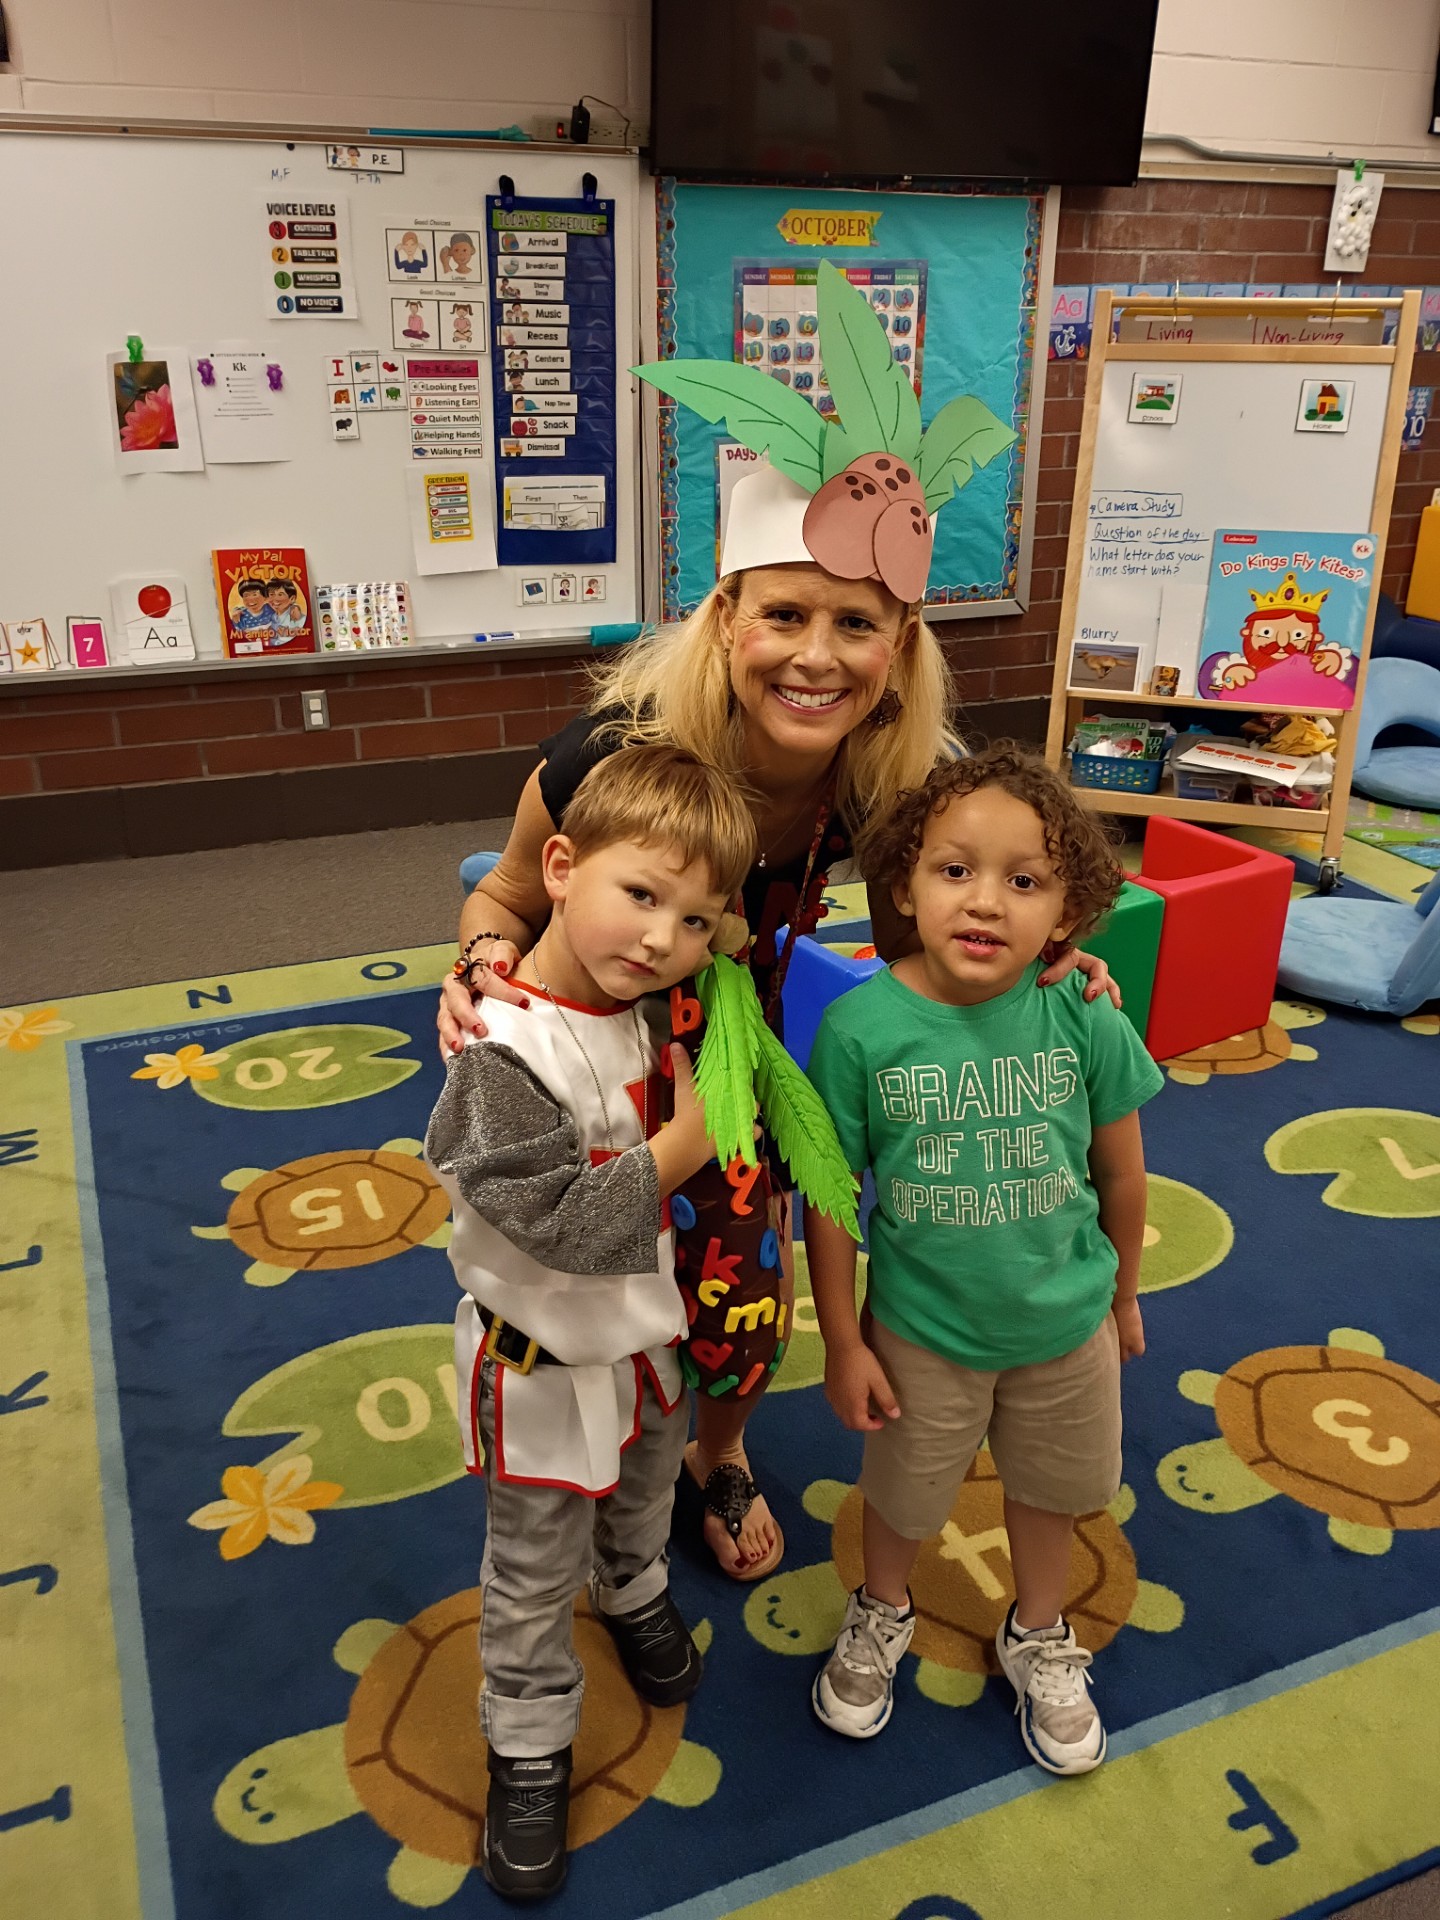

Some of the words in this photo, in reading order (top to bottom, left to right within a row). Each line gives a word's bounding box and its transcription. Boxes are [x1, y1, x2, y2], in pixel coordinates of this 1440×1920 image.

[372, 154, 391, 165] P.E.
[266, 203, 298, 216] VOICE
[300, 203, 336, 217] LEVELS
[294, 224, 331, 233] OUTSIDE
[498, 212, 541, 228] TODAY'S
[546, 215, 599, 231] SCHEDULE
[791, 217, 866, 237] OCTOBER
[527, 237, 559, 247] Arrival
[276, 248, 285, 262] 2
[313, 249, 335, 258] TALK
[525, 262, 559, 271] Breakfast
[297, 273, 337, 283] WHISPER
[300, 298, 313, 307] NO
[1054, 294, 1084, 318] Aa
[535, 309, 562, 319] Music
[776, 321, 784, 334] 5
[803, 319, 812, 332] 6
[895, 320, 910, 332] 10
[1146, 321, 1193, 344] Living
[1262, 326, 1344, 345] Non-Living
[527, 331, 559, 341] Recess
[535, 354, 564, 364] Centers
[747, 346, 761, 358] 11
[773, 347, 788, 361] 12
[796, 346, 812, 358] 13
[232, 362, 247, 371] Kk
[425, 384, 457, 392] Looking
[458, 384, 477, 392] Eyes
[535, 377, 559, 387] Lunch
[796, 373, 813, 388] 20
[425, 399, 460, 407] Listening
[428, 415, 451, 423] Quiet
[453, 415, 480, 423] Mouth
[543, 420, 569, 430] Snack
[1312, 422, 1333, 430] Home
[1410, 416, 1426, 438] 10
[424, 431, 454, 441] Helping
[456, 431, 480, 439] Hands
[430, 448, 462, 458] Walking
[527, 443, 560, 451] Dismissal
[725, 449, 758, 461] DAYS
[1097, 497, 1139, 514] Camera
[1141, 497, 1176, 517] Study
[1094, 523, 1142, 540] Question
[1147, 527, 1161, 539] of
[1161, 528, 1180, 538] the
[1355, 544, 1369, 553] Kk
[240, 552, 259, 563] My
[1090, 547, 1119, 561] What
[1123, 547, 1154, 561] letter
[1155, 549, 1175, 561] does
[1177, 553, 1205, 567] your
[224, 564, 303, 583] VICTOR
[1087, 566, 1117, 577] name
[1121, 565, 1148, 575] start
[1151, 564, 1180, 578] with?
[1221, 562, 1242, 576] Do
[1248, 555, 1287, 571] Kings
[1293, 554, 1315, 570] Fly
[1320, 557, 1364, 580] Kites?
[144, 627, 178, 648] Aa
[245, 629, 275, 641] amigo
[277, 627, 311, 637] Victor
[1081, 627, 1119, 642] Blurry
[83, 637, 94, 652] 7
[186, 984, 232, 1009] N
[671, 986, 704, 1036] b
[235, 1046, 342, 1090] 20
[876, 1047, 1078, 1125] BRAINS
[916, 1132, 964, 1174] OF
[976, 1122, 1049, 1172] THE
[892, 1166, 1079, 1226] OPERATION
[290, 1179, 386, 1236] 15
[702, 1237, 743, 1285] k
[698, 1279, 730, 1307] c
[724, 1297, 776, 1333] m
[1312, 1399, 1411, 1466] 3
[1225, 1769, 1299, 1867] F
